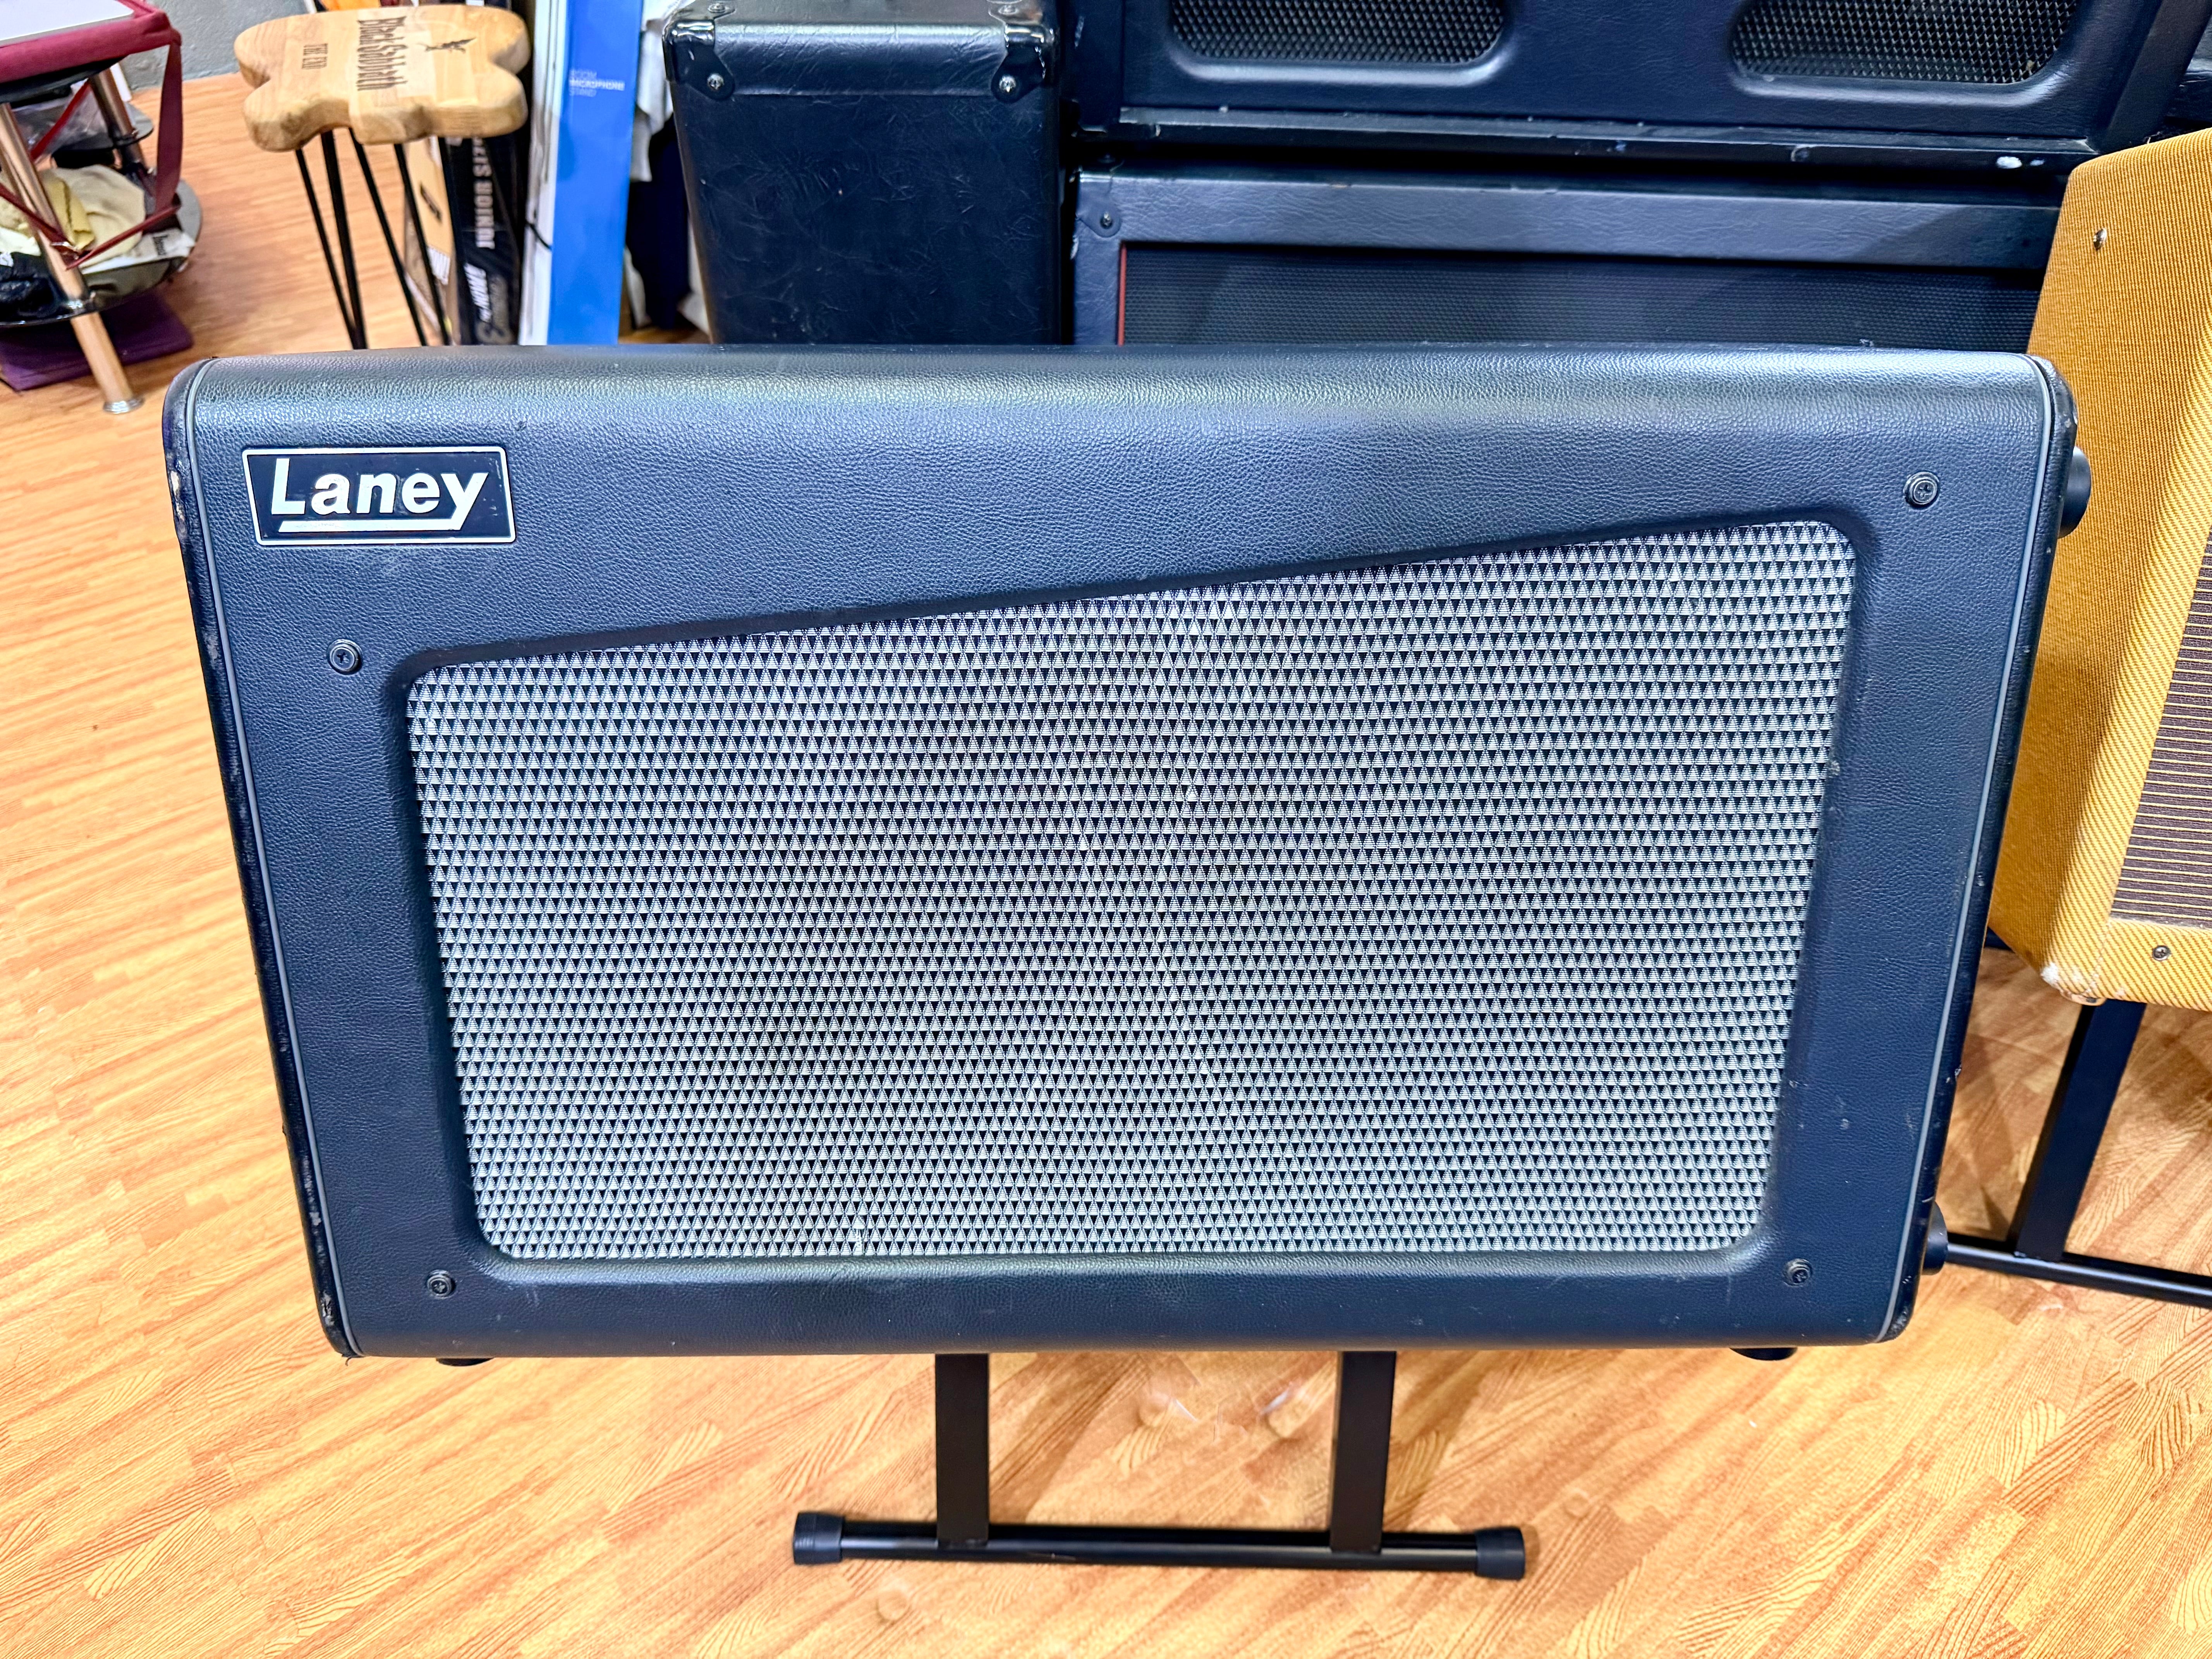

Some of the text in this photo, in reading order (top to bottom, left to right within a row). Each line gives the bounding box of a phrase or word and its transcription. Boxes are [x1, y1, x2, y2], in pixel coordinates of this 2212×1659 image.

[302, 43, 328, 70] THE END
[356, 16, 409, 91] Black Sabbath
[474, 180, 495, 249] JUNIOR
[271, 458, 489, 532] Laney
